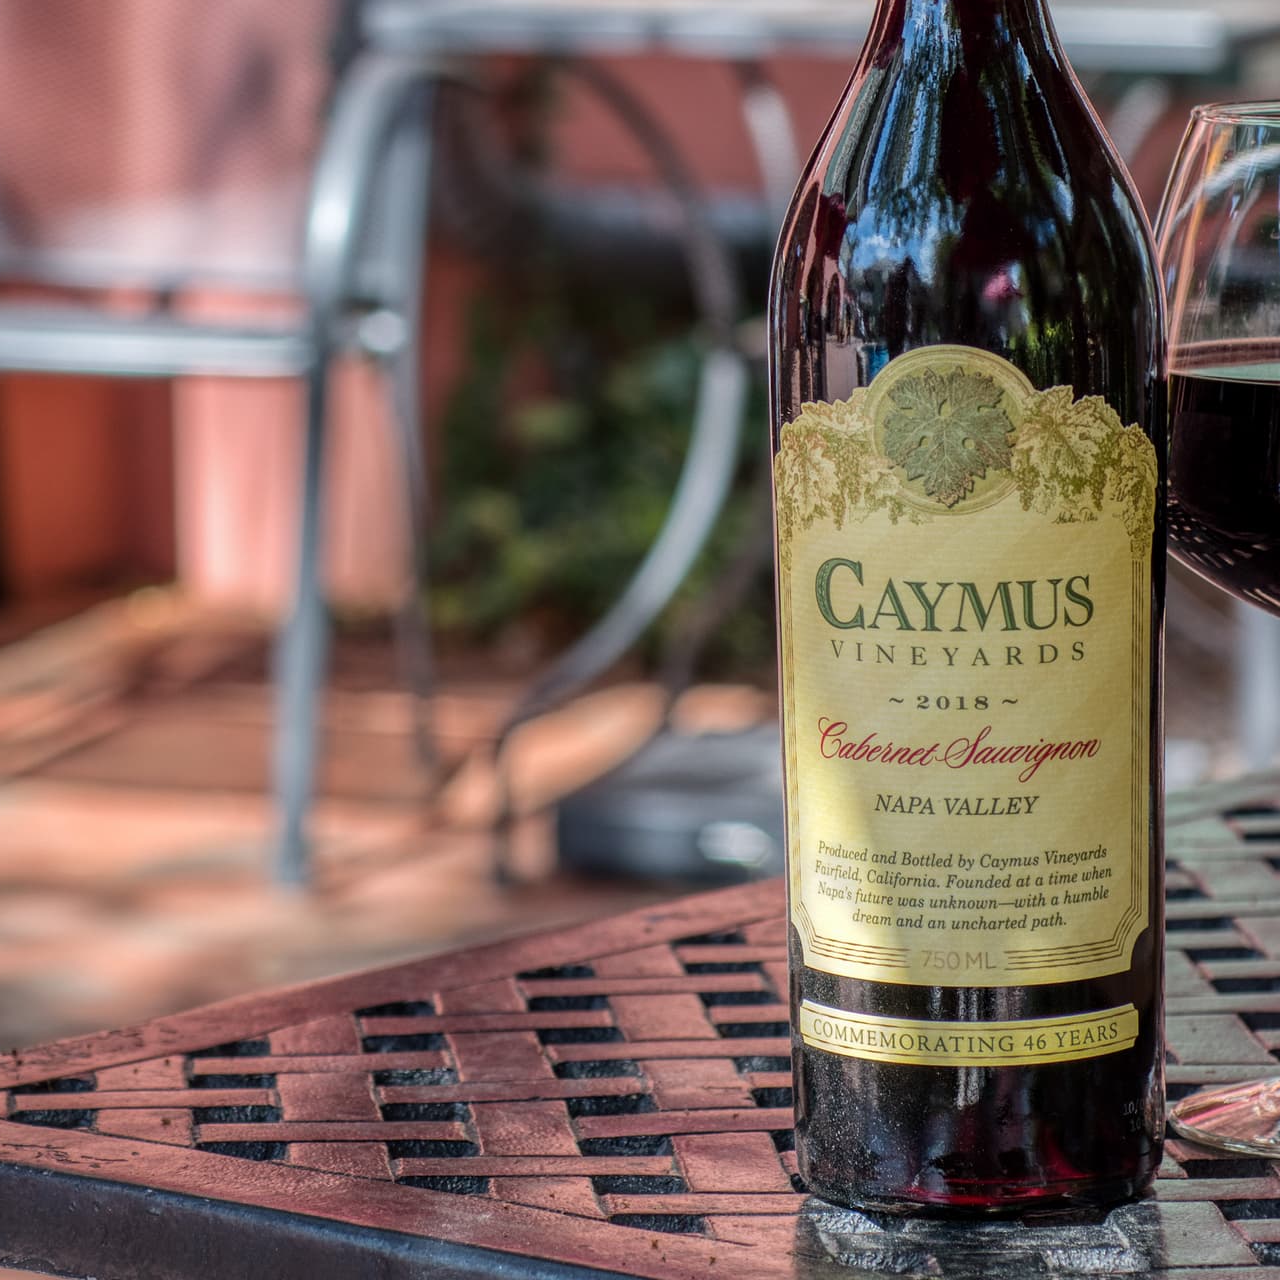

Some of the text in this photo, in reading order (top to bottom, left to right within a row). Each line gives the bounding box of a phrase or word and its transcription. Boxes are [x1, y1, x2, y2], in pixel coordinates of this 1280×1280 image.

[814, 557, 1095, 632] CAYMUS
[830, 638, 1086, 667] VINEYARDS
[916, 695, 990, 710] 2018
[817, 716, 1102, 783] Cabernet Sauvignon
[874, 793, 1040, 816] NAPA VALLEY
[818, 840, 1108, 871] Produced and Bottled by Caymus Vineyards
[815, 860, 1112, 889] Fairfield, California. Founded at a time when
[818, 880, 853, 901] Napa's
[855, 888, 894, 906] future
[897, 897, 925, 909] was
[1050, 896, 1060, 907] a
[1063, 885, 1110, 905] humble
[852, 908, 1068, 932] dream and an uncharted path.
[921, 950, 998, 970] 750 ML
[812, 1018, 1119, 1054] COMMEMORATING 46 YEARS
